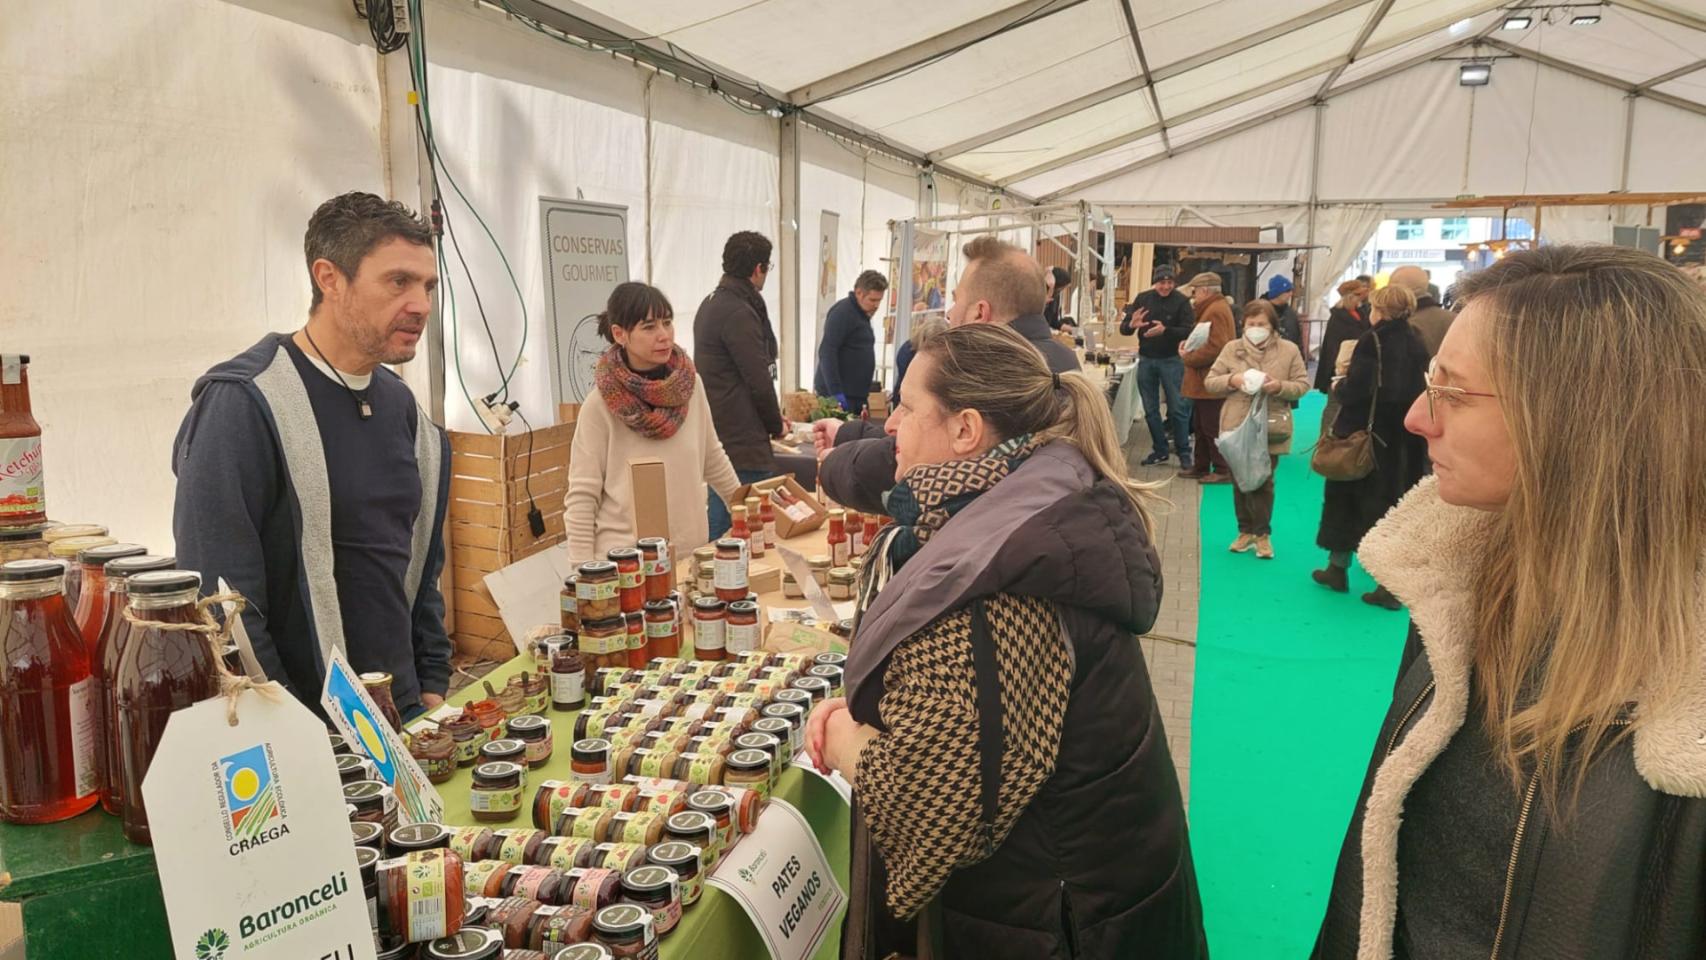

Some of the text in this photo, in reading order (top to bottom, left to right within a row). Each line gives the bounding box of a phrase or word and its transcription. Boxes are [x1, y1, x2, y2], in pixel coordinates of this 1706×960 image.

[553, 235, 623, 255] CONSERVAS
[562, 264, 618, 282] GOURMET
[0, 443, 42, 482] etchu
[264, 742, 279, 784] AGRICULTURA
[213, 772, 226, 809] REGULADOR
[220, 809, 233, 842] CONSELLO
[229, 824, 290, 856] CRAEGA
[772, 855, 801, 899] PATES
[239, 871, 348, 939] Baronceli
[779, 870, 821, 939] VEGANOS
[243, 922, 298, 951] AGRICULTURA
